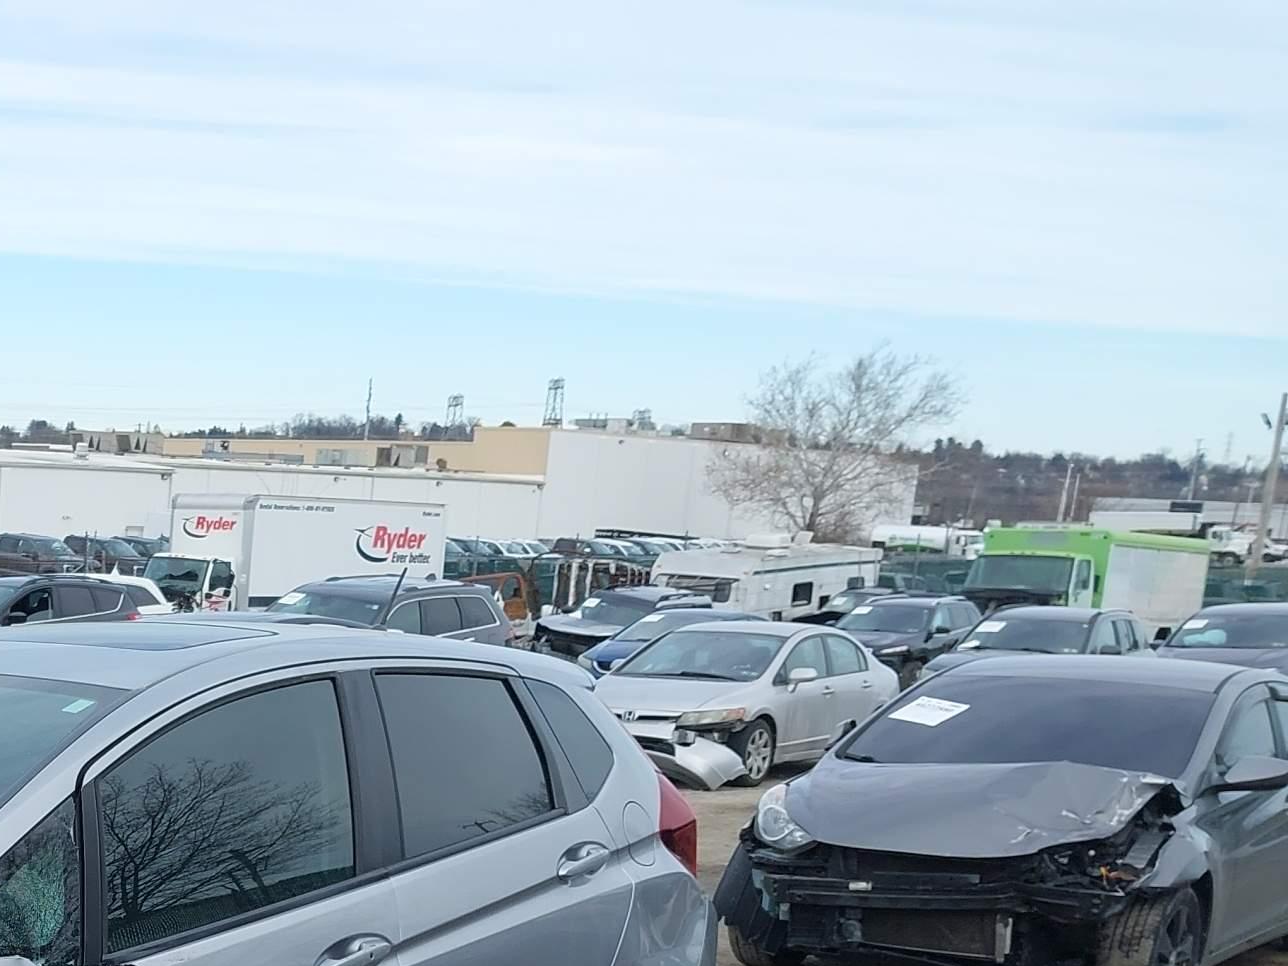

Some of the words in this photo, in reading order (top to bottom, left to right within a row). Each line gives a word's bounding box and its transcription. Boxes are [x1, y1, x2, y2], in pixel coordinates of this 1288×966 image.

[195, 516, 237, 534] Ryder
[372, 526, 426, 554] Ryder
[391, 551, 408, 563] Ever
